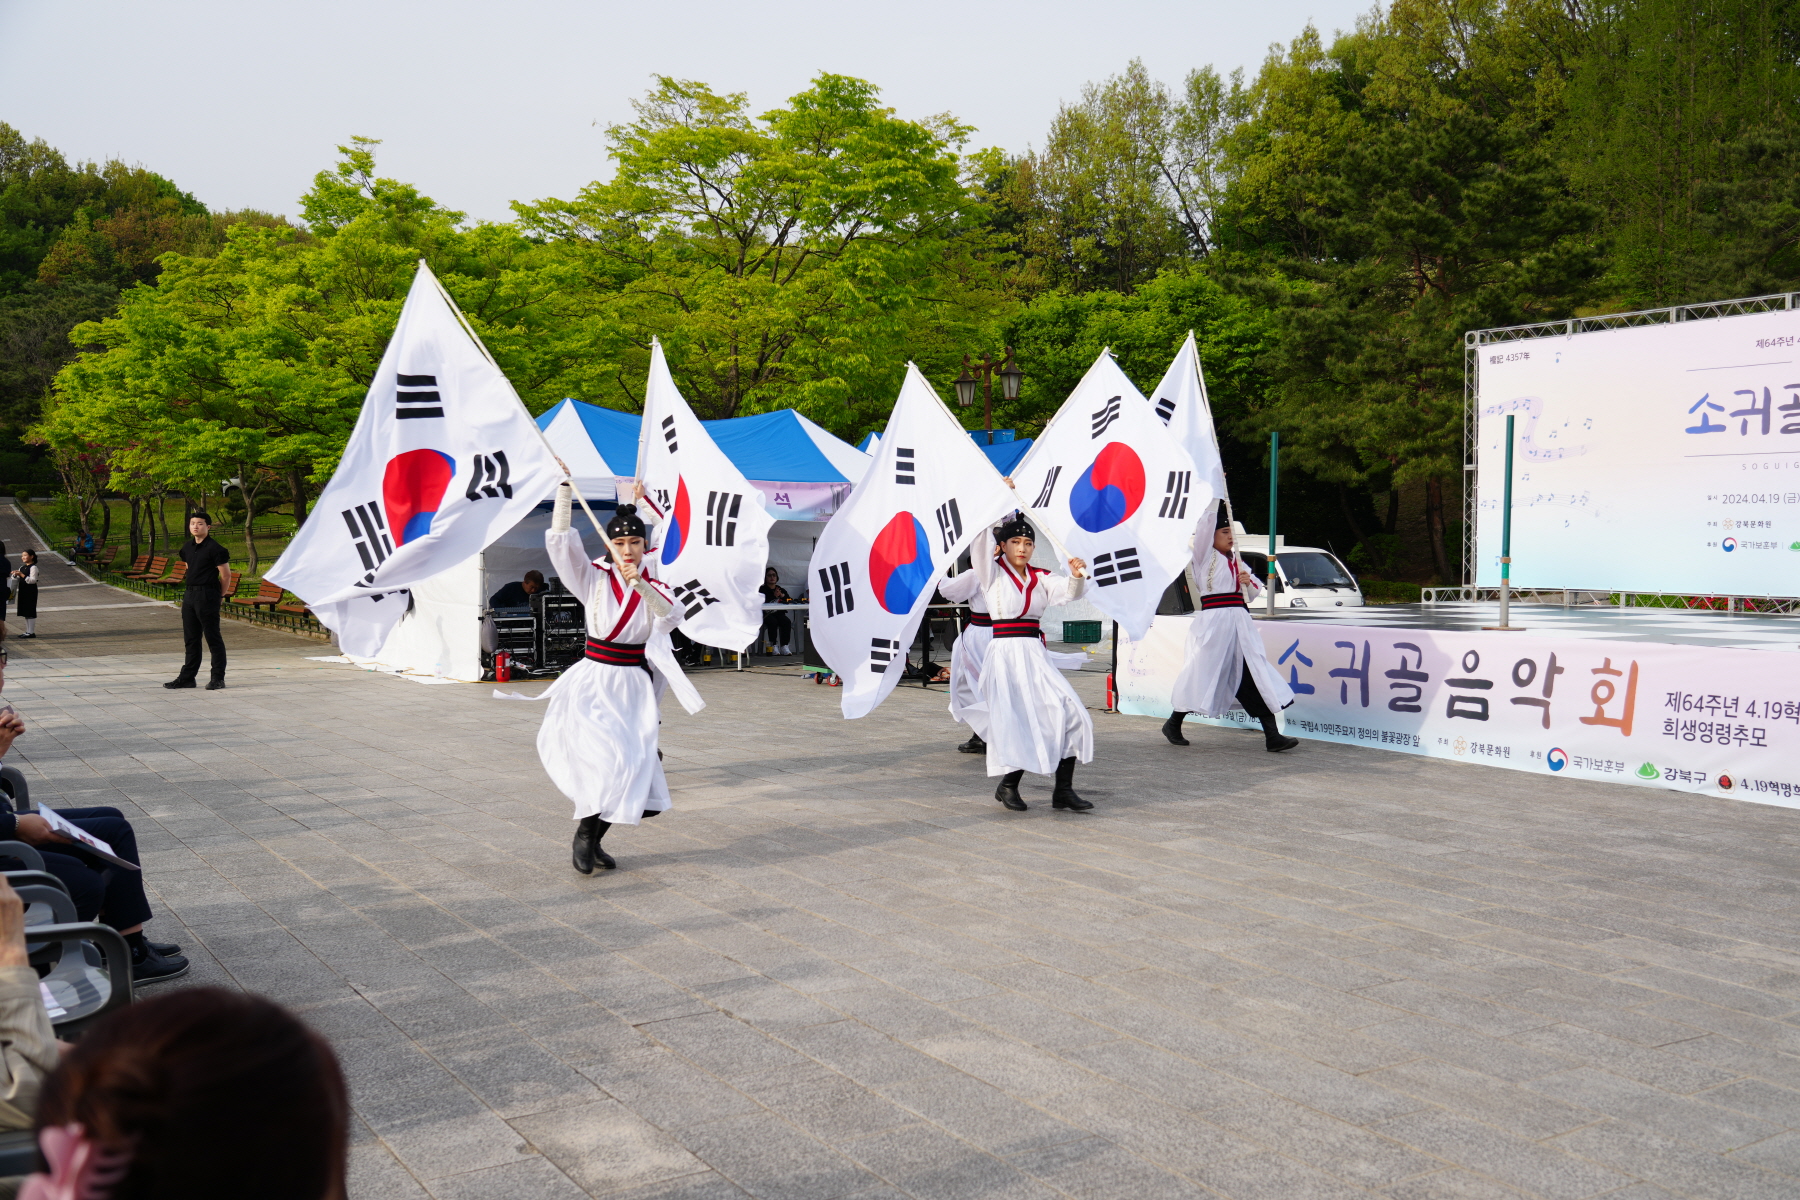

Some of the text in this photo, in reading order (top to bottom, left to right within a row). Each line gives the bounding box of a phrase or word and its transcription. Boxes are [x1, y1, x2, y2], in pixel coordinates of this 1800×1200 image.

[1755, 336, 1794, 349] 제64주년
[1722, 494, 1780, 505] 2024.04.19
[1783, 493, 1800, 505] (금)
[1735, 520, 1772, 529] 강북문화원
[1740, 541, 1778, 550] 국가보훈부
[1664, 691, 1740, 719] 제64주년
[1300, 720, 1356, 738] 국립4.19민주묘지
[1358, 727, 1379, 741] 정의의
[1381, 730, 1411, 746] 불꽃광장
[1412, 735, 1421, 748] 앞
[1662, 717, 1767, 748] 희생영령추모
[1470, 742, 1511, 759] 강북문화원
[1573, 756, 1625, 774] 국가보훈부
[1664, 767, 1707, 784] 강북구
